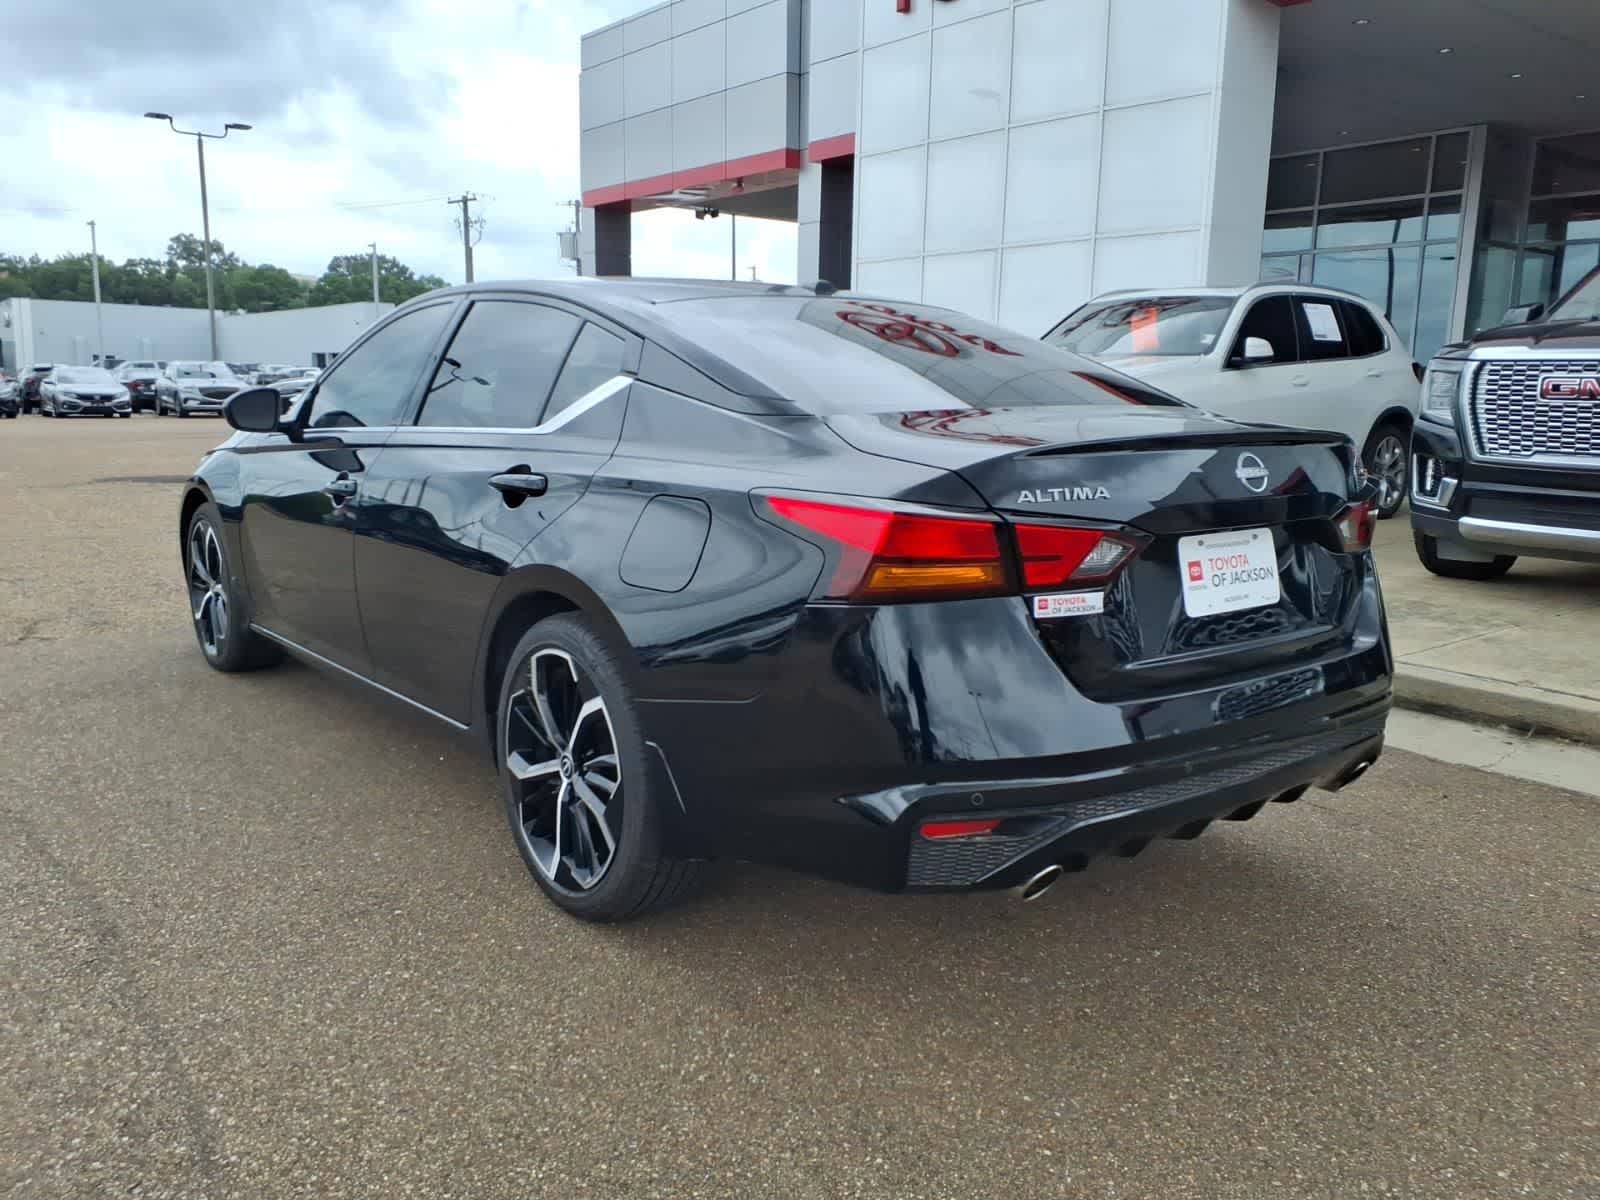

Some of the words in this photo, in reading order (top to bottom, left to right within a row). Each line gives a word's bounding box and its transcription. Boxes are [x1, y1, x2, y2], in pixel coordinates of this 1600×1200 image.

[1017, 486, 1111, 503] ALTIMA
[1208, 554, 1249, 572] TOYOTA
[1211, 573, 1226, 588] OF
[1229, 566, 1274, 585] JACKSON
